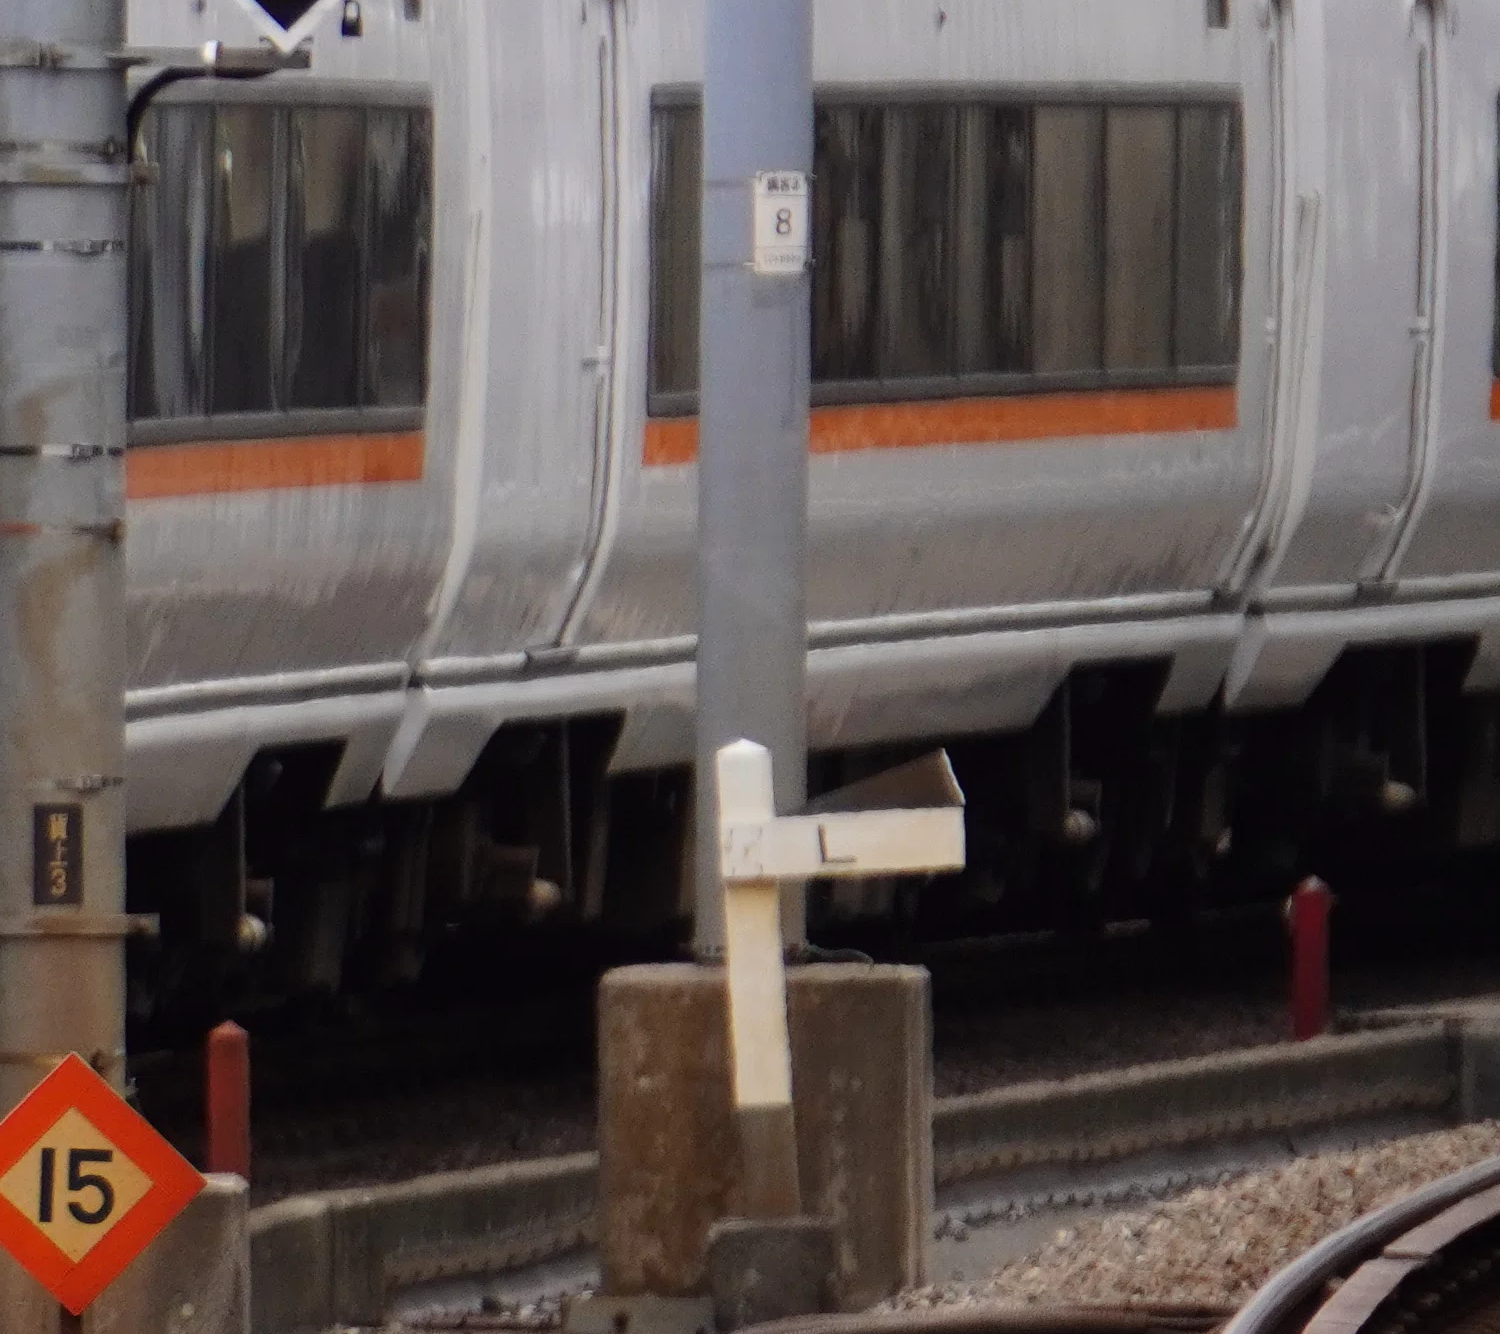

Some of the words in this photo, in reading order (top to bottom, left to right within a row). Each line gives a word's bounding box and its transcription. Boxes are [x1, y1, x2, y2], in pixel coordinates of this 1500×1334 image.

[775, 208, 793, 236] 8
[817, 823, 857, 864] L
[39, 1147, 115, 1224] 15
